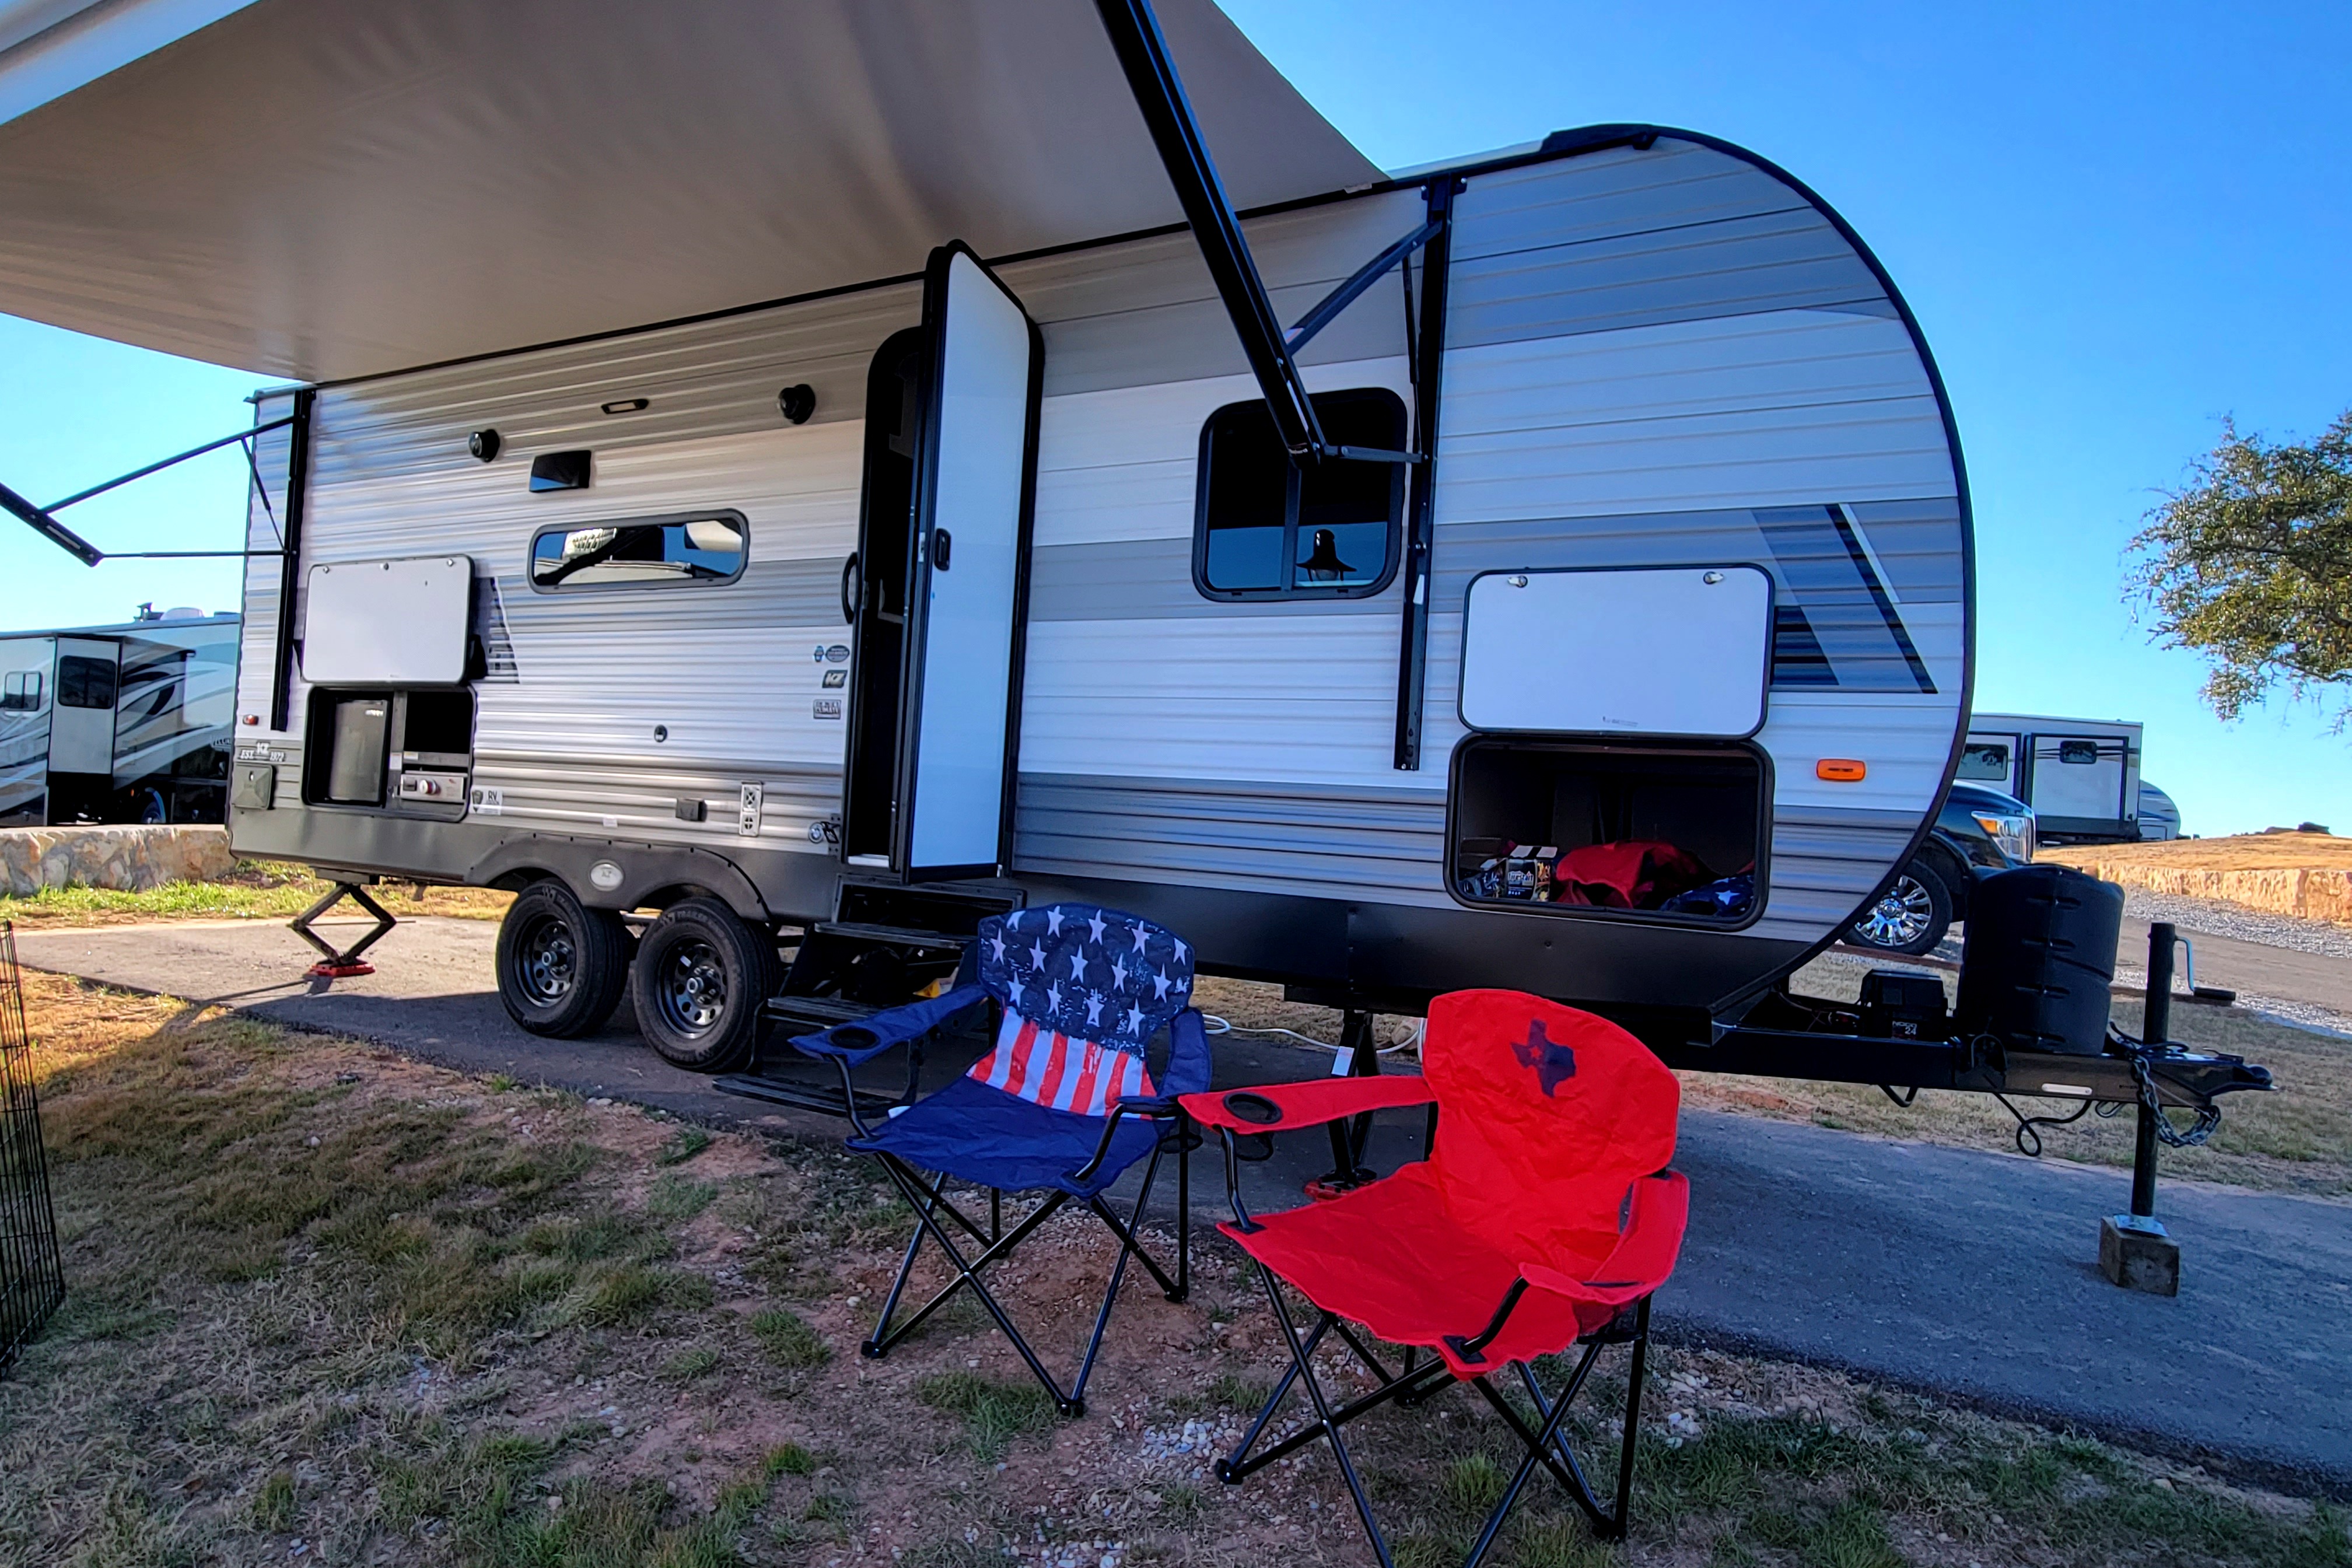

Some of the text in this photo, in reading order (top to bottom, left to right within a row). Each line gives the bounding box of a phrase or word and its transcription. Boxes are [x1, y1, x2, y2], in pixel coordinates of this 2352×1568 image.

[824, 673, 845, 686] KZ
[257, 742, 269, 754] KZ
[270, 751, 284, 762] 1972
[488, 790, 498, 802] RV
[1905, 1026, 1917, 1035] 24
